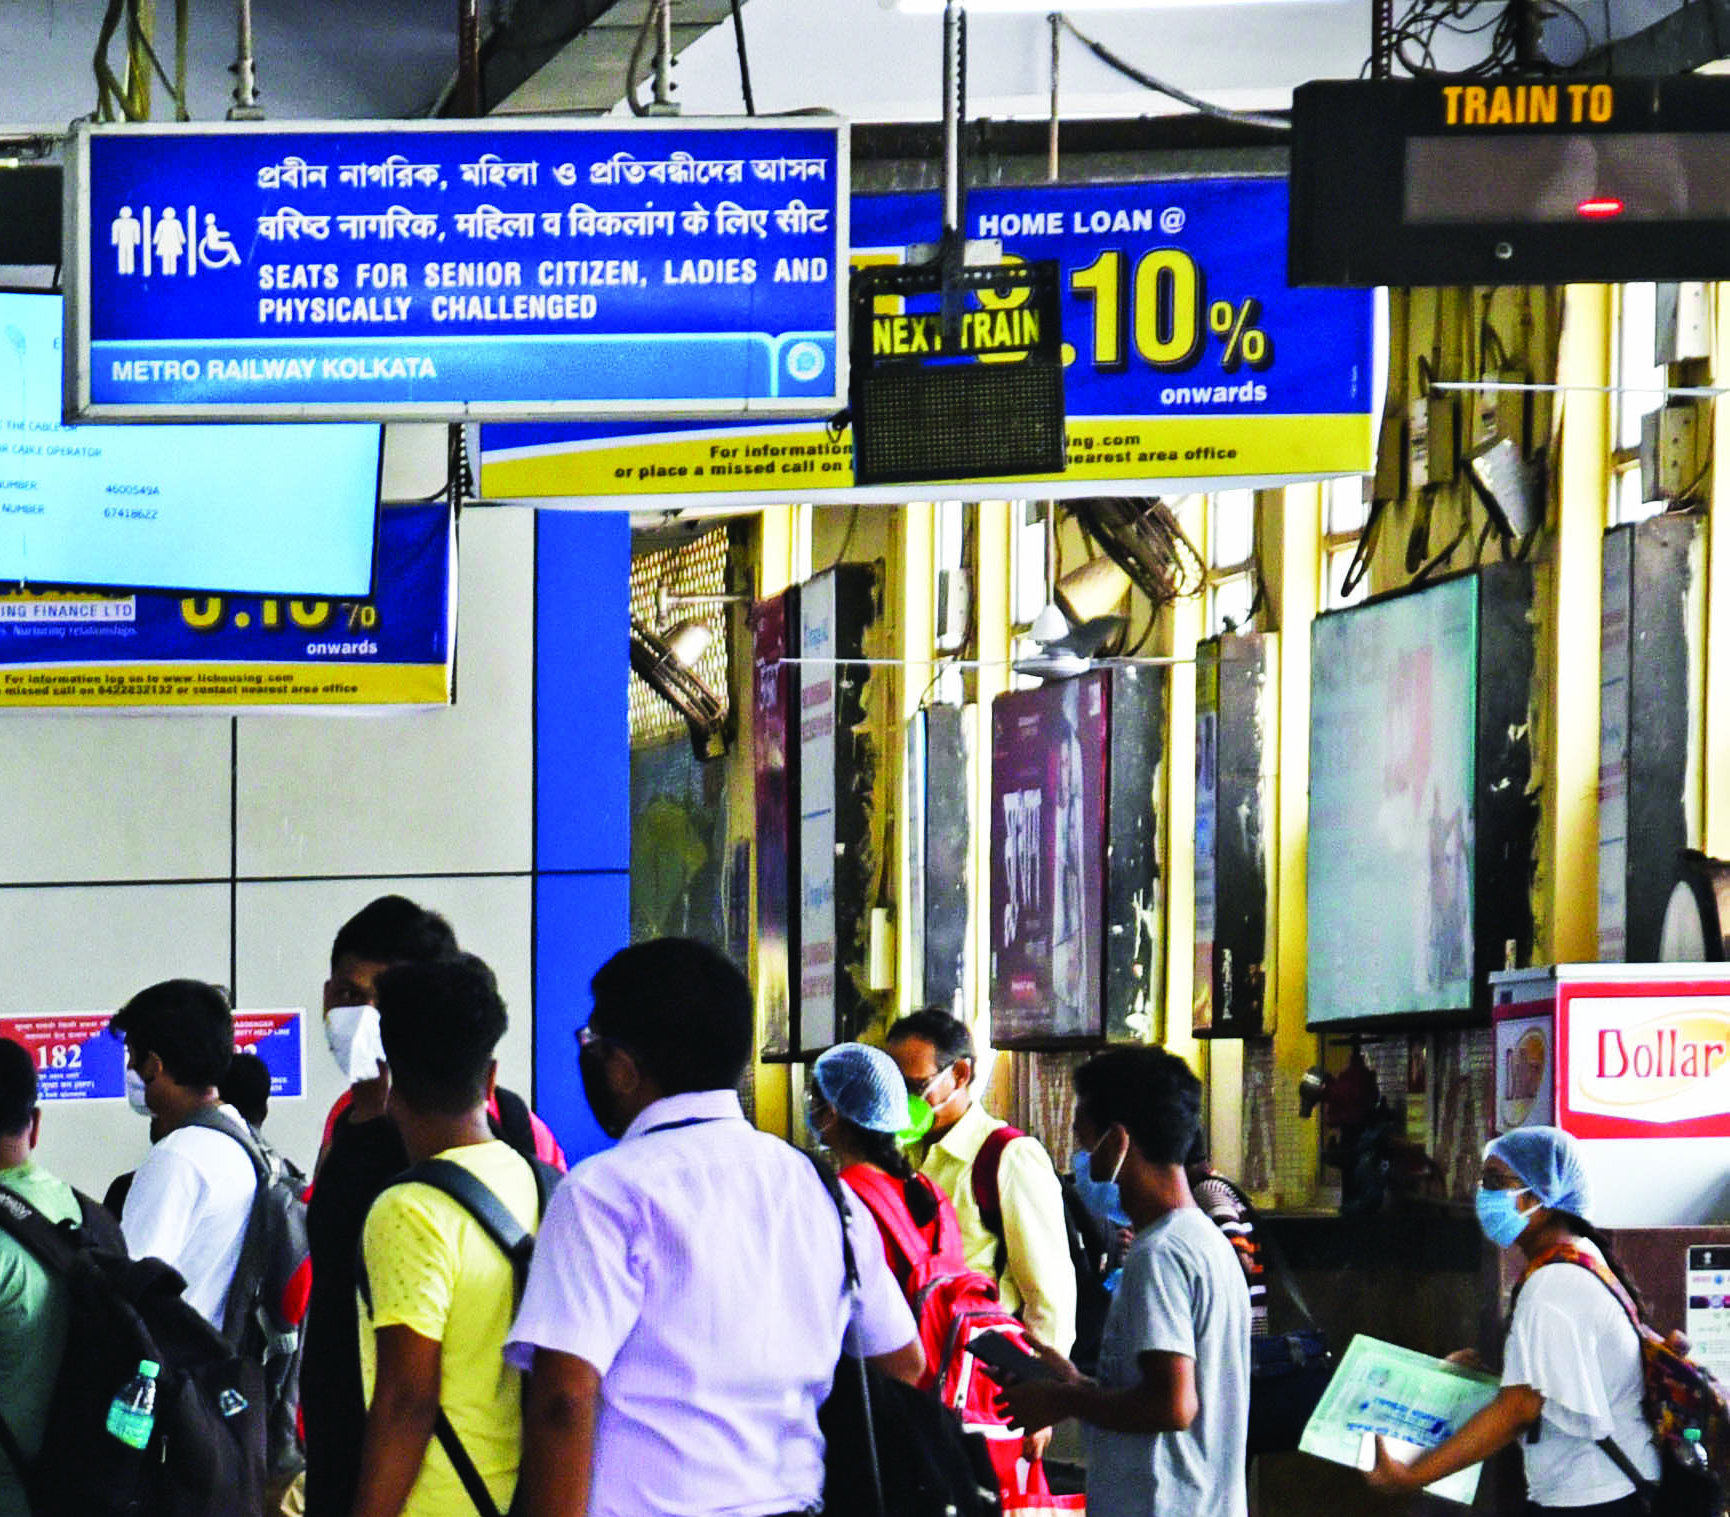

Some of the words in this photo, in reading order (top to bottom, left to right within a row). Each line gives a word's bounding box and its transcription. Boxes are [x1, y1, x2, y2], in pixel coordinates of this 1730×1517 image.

[1443, 85, 1558, 126] TRAIN
[1567, 84, 1614, 124] TO
[338, 155, 448, 191] নাগরিক,
[459, 153, 538, 187] মহিলা
[553, 163, 577, 186] ও
[750, 157, 828, 182] আসন
[257, 206, 331, 241] वरिष्ठ
[336, 205, 446, 242] नागरिक,
[454, 204, 535, 240] महिला
[541, 212, 562, 236] व
[568, 200, 675, 237] विकलांग
[681, 201, 710, 234] के
[715, 200, 768, 238] लिए
[773, 199, 829, 234] सीट
[979, 212, 1064, 237] HOME
[1073, 208, 1154, 233] LOAN
[1158, 207, 1186, 235] @
[259, 264, 339, 289] SEATS
[356, 263, 408, 288] FOR
[424, 262, 522, 288] SENIOR
[538, 260, 647, 288] CITIZEN,
[664, 258, 757, 285] LADIES
[773, 257, 828, 283] AND
[259, 297, 412, 323] PHYSICALLY
[432, 294, 597, 322] CHALLENGED
[961, 309, 1039, 350] TRAIN
[111, 358, 200, 382] METRO
[205, 357, 316, 382] RAILWAY
[322, 356, 437, 381] KOLKATA
[1161, 380, 1268, 405] onwards
[46, 445, 102, 457] OPERATOR
[614, 465, 633, 479] or
[639, 464, 688, 480] place
[694, 465, 704, 476] a
[710, 460, 776, 476] missed
[781, 460, 815, 474] call
[822, 461, 841, 473] on
[1137, 449, 1178, 463] area
[1184, 446, 1237, 461] office
[710, 445, 739, 459] For
[745, 442, 853, 458] information
[33, 603, 98, 617] FINANCE
[104, 603, 132, 617] LTD
[307, 640, 378, 654] onwards
[38, 1044, 82, 1069] 182
[1596, 1029, 1724, 1079] Dollar
